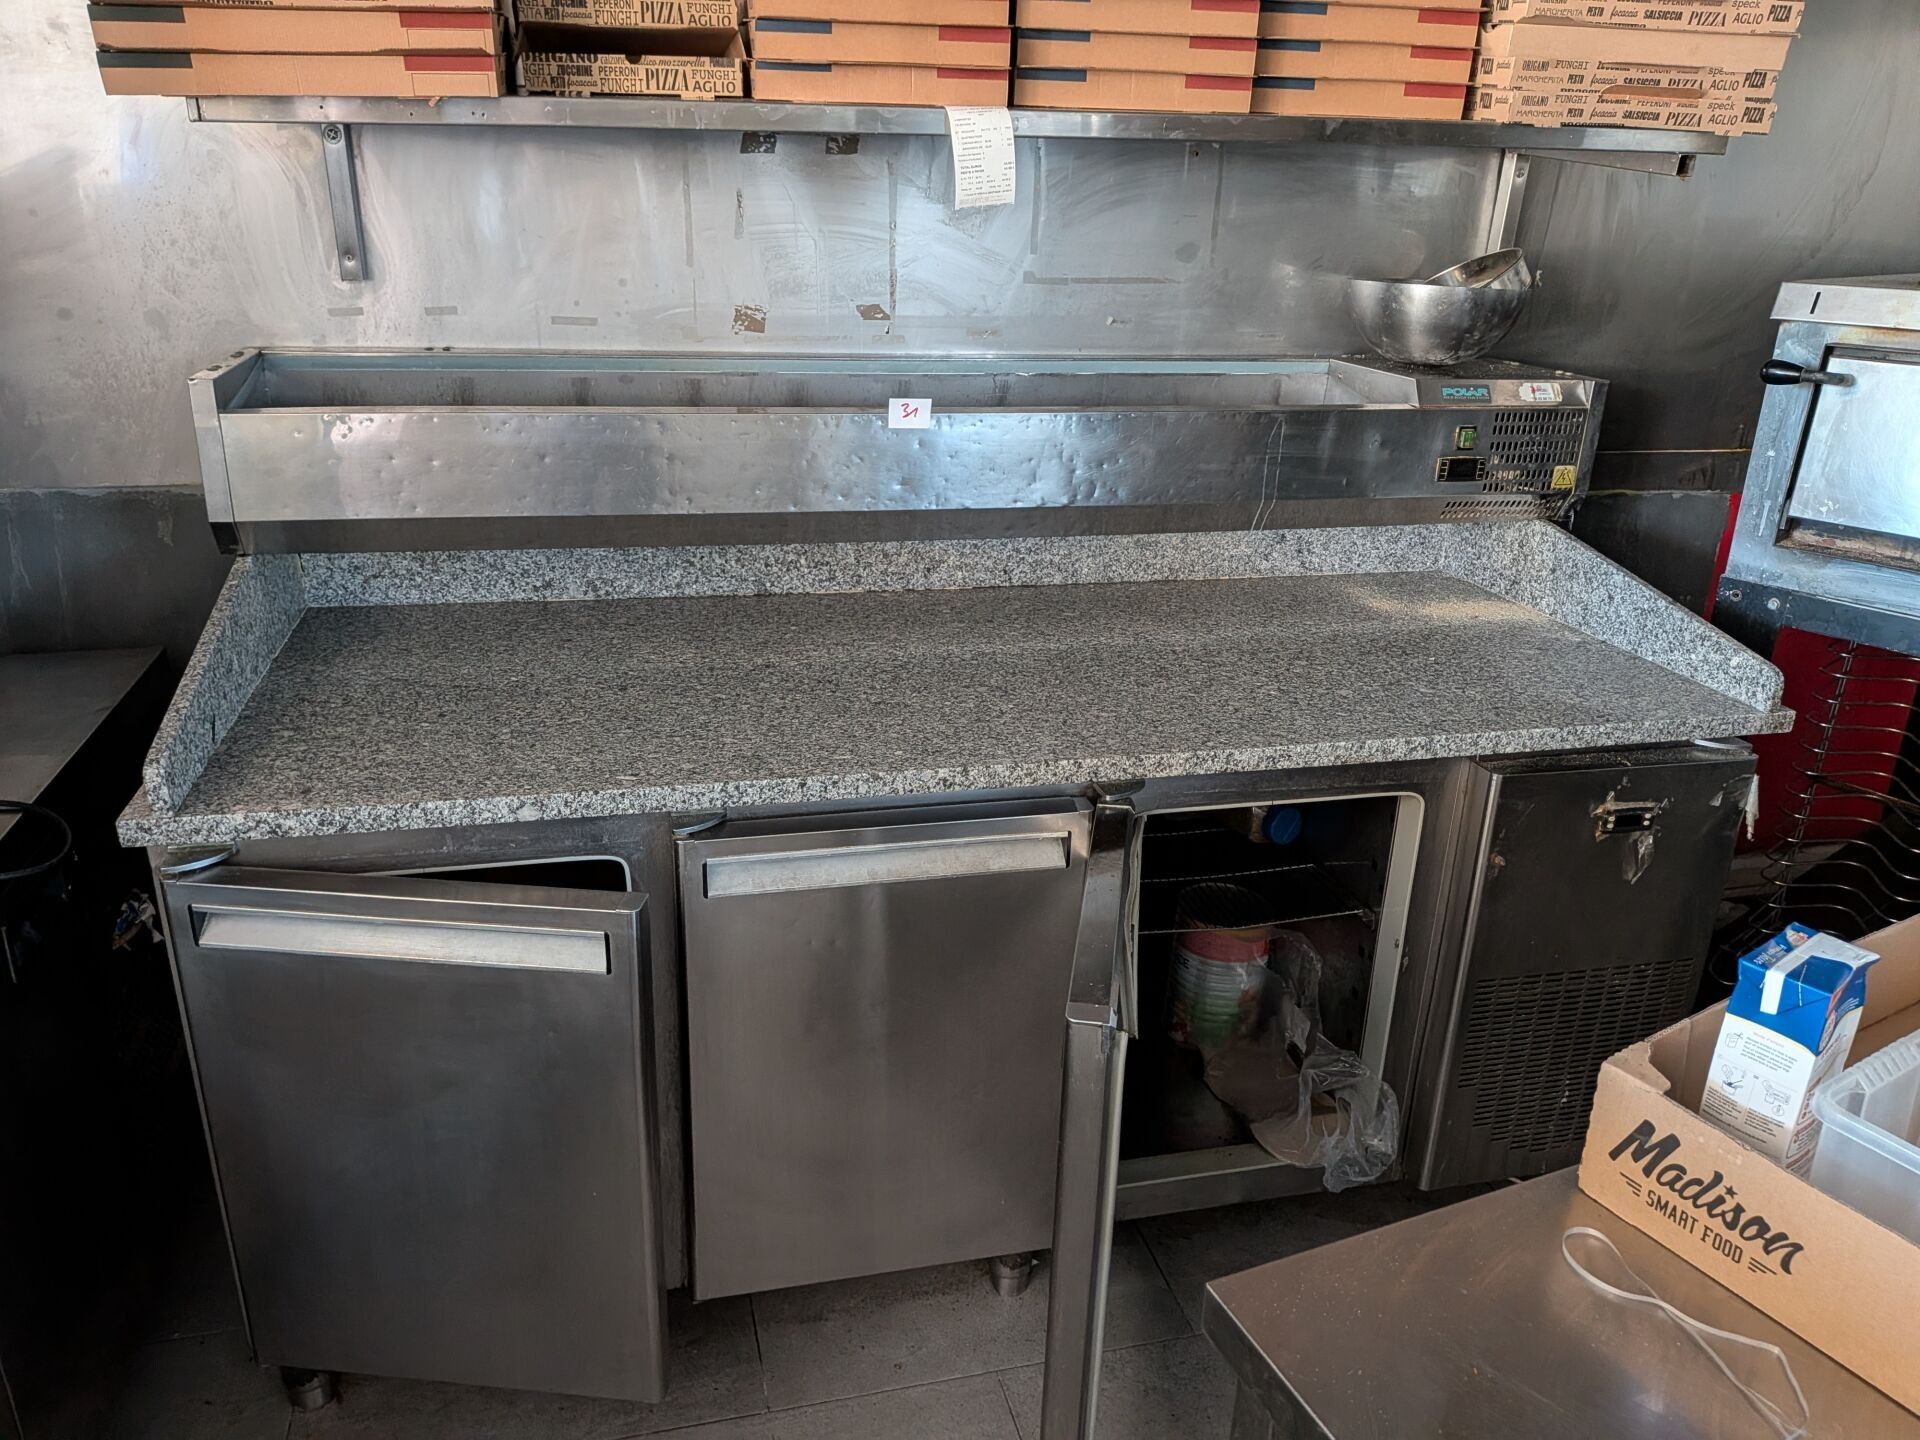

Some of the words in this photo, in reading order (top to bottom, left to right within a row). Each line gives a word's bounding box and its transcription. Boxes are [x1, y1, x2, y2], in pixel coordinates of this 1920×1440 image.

[640, 1, 684, 25] PIZZA
[686, 2, 733, 14] FUNGHI
[1767, 4, 1793, 22] PIZZA
[594, 10, 639, 25] FUNGHI
[688, 14, 731, 26] AGLIO
[1586, 6, 1604, 17] PESTO
[1643, 9, 1683, 20] SALSICCIA
[1688, 10, 1727, 27] PIZZA
[1732, 12, 1764, 25] AGLIO
[598, 66, 639, 77] PEPERONI
[1522, 60, 1549, 72] ORIGANO
[1554, 60, 1590, 70] FUNGHI
[645, 68, 689, 92] PIZZA
[691, 69, 737, 80] FUNGHI
[1516, 75, 1564, 84] MARGHERITA
[1567, 74, 1585, 85] PESTO
[1709, 80, 1740, 91] AGLIO
[1742, 71, 1768, 89] PIZZA
[600, 77, 644, 93] FUNGHI
[693, 81, 736, 94] AGLIO
[1521, 96, 1549, 106] ORIGANO
[1554, 95, 1589, 104] FUNGHI
[1707, 101, 1735, 112] speck
[1516, 109, 1564, 118] MARGHERITA
[1566, 108, 1584, 118] PESTO
[1622, 110, 1661, 121] SALSICCIA
[1664, 111, 1703, 127] PIZZA
[1707, 114, 1738, 126] AGLIO
[1741, 107, 1766, 124] PIZZA
[1442, 387, 1489, 396] POLAR
[1608, 1119, 1804, 1275] Madison
[1646, 1189, 1699, 1234] SMART
[1700, 1224, 1743, 1264] FOOD
